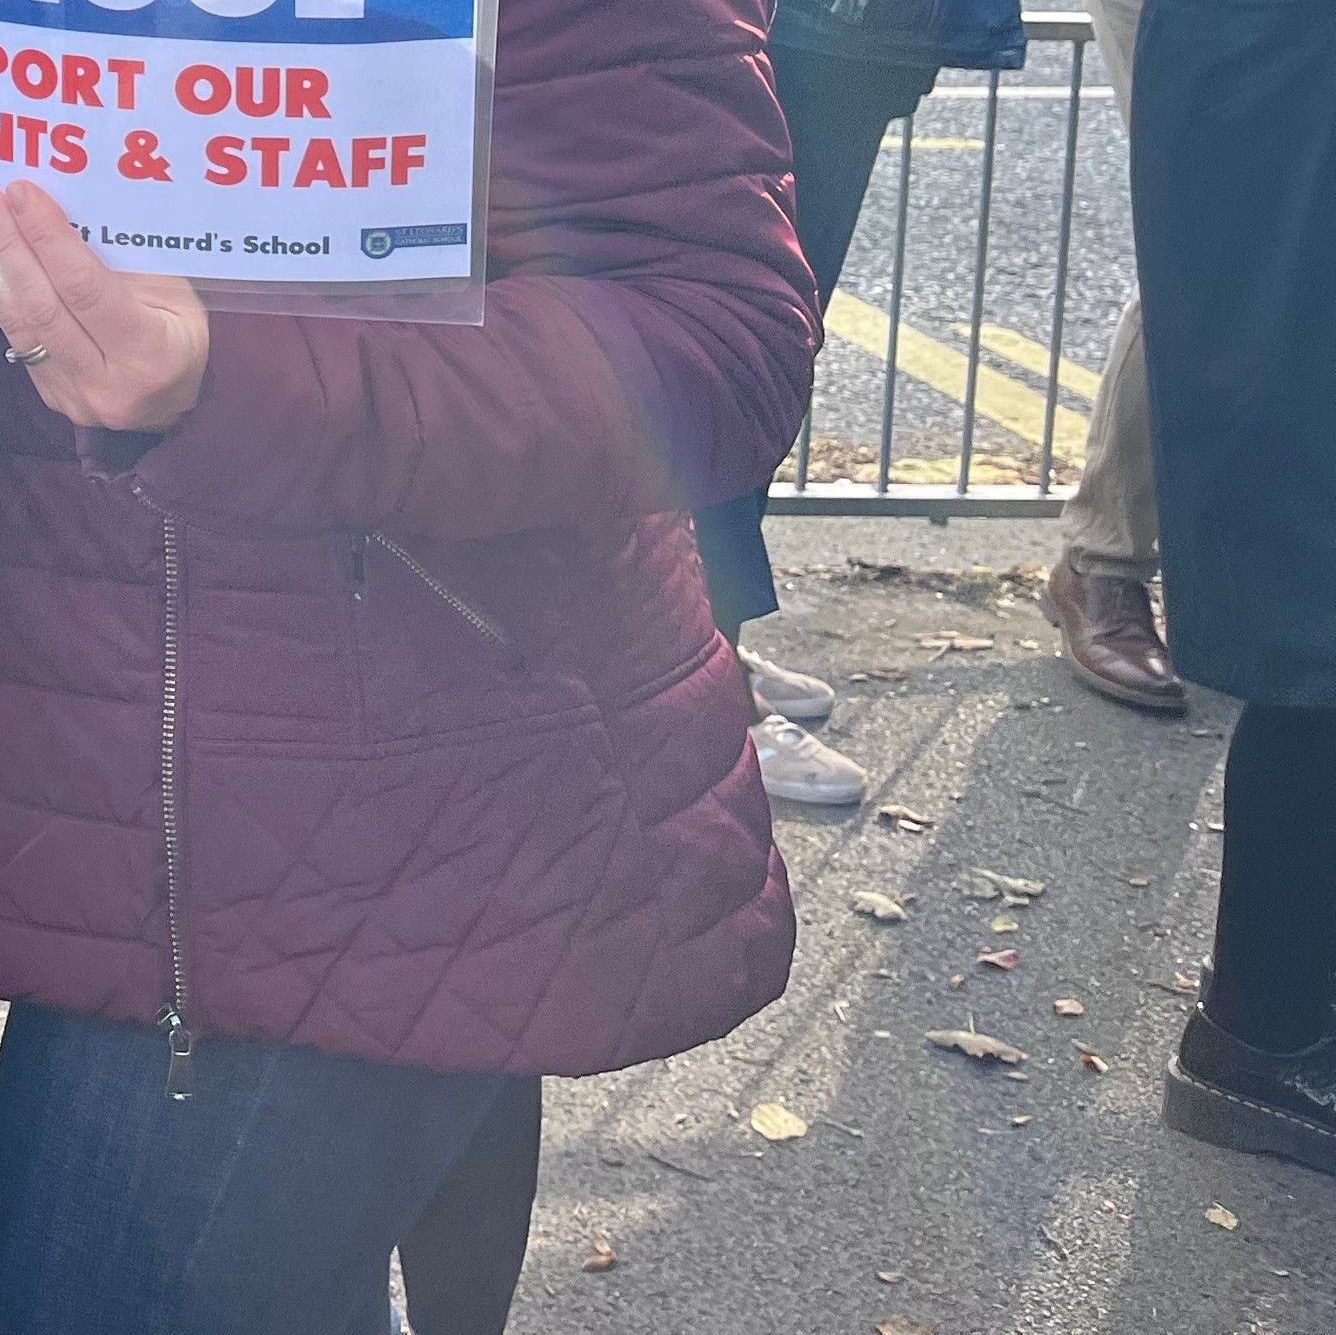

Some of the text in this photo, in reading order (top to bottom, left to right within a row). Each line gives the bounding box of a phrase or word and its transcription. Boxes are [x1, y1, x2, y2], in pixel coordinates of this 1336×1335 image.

[174, 63, 331, 119] OUR
[117, 130, 173, 183] &
[204, 133, 427, 189] STAFF
[101, 226, 232, 253] Leonard's
[243, 235, 330, 255] School
